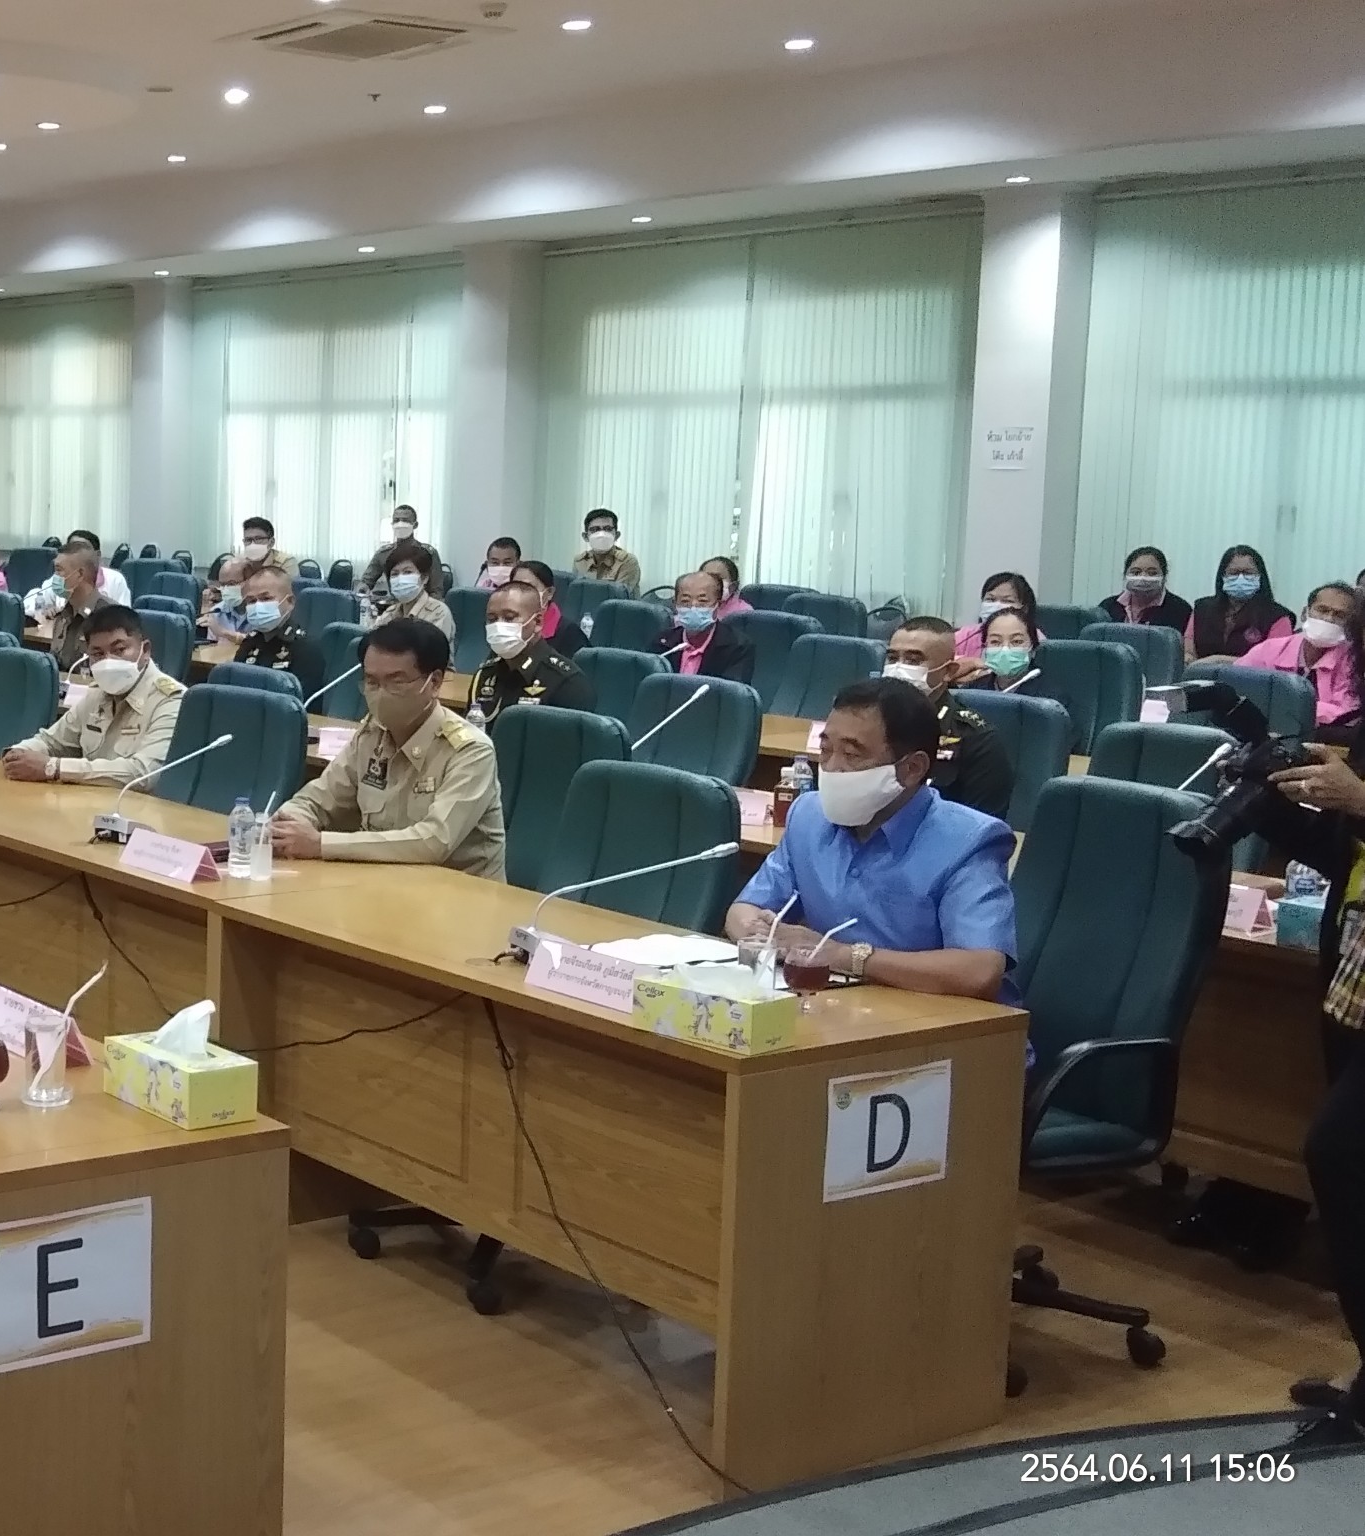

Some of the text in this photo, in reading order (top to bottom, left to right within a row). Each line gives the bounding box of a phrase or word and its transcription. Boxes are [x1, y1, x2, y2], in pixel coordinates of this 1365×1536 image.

[637, 983, 665, 998] Cellox
[866, 1093, 911, 1174] D
[37, 1237, 84, 1339] E
